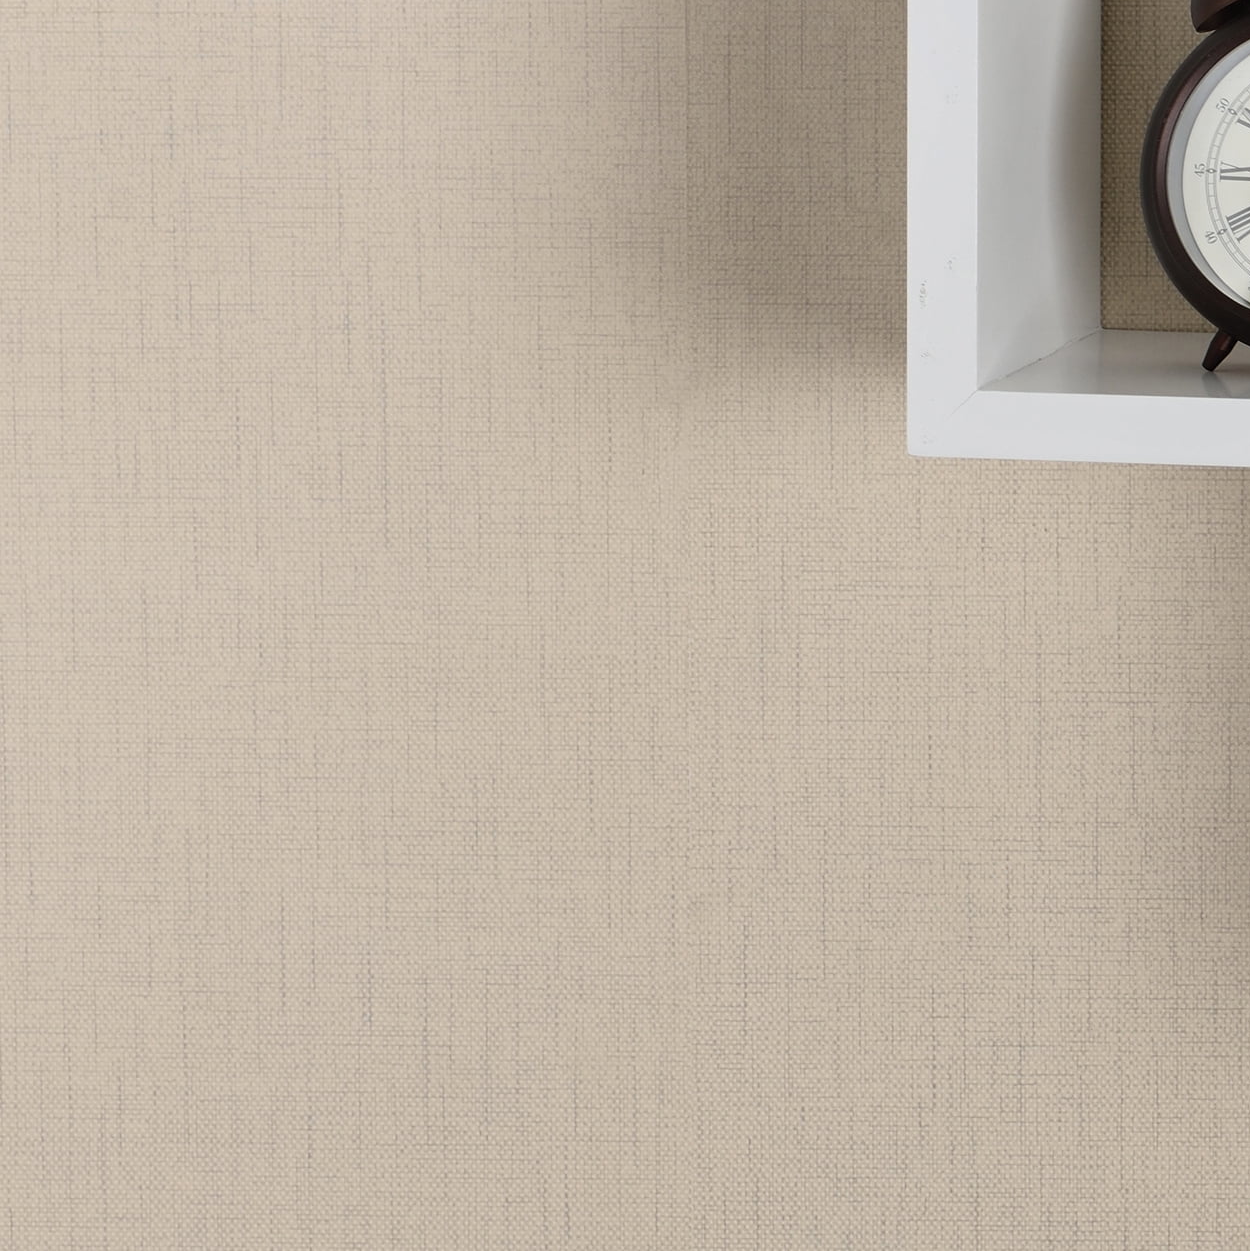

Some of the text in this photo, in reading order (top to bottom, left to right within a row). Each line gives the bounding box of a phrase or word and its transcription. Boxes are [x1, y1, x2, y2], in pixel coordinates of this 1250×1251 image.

[1215, 97, 1230, 113] 50
[1194, 162, 1206, 177] 45
[1205, 230, 1218, 244] 40
